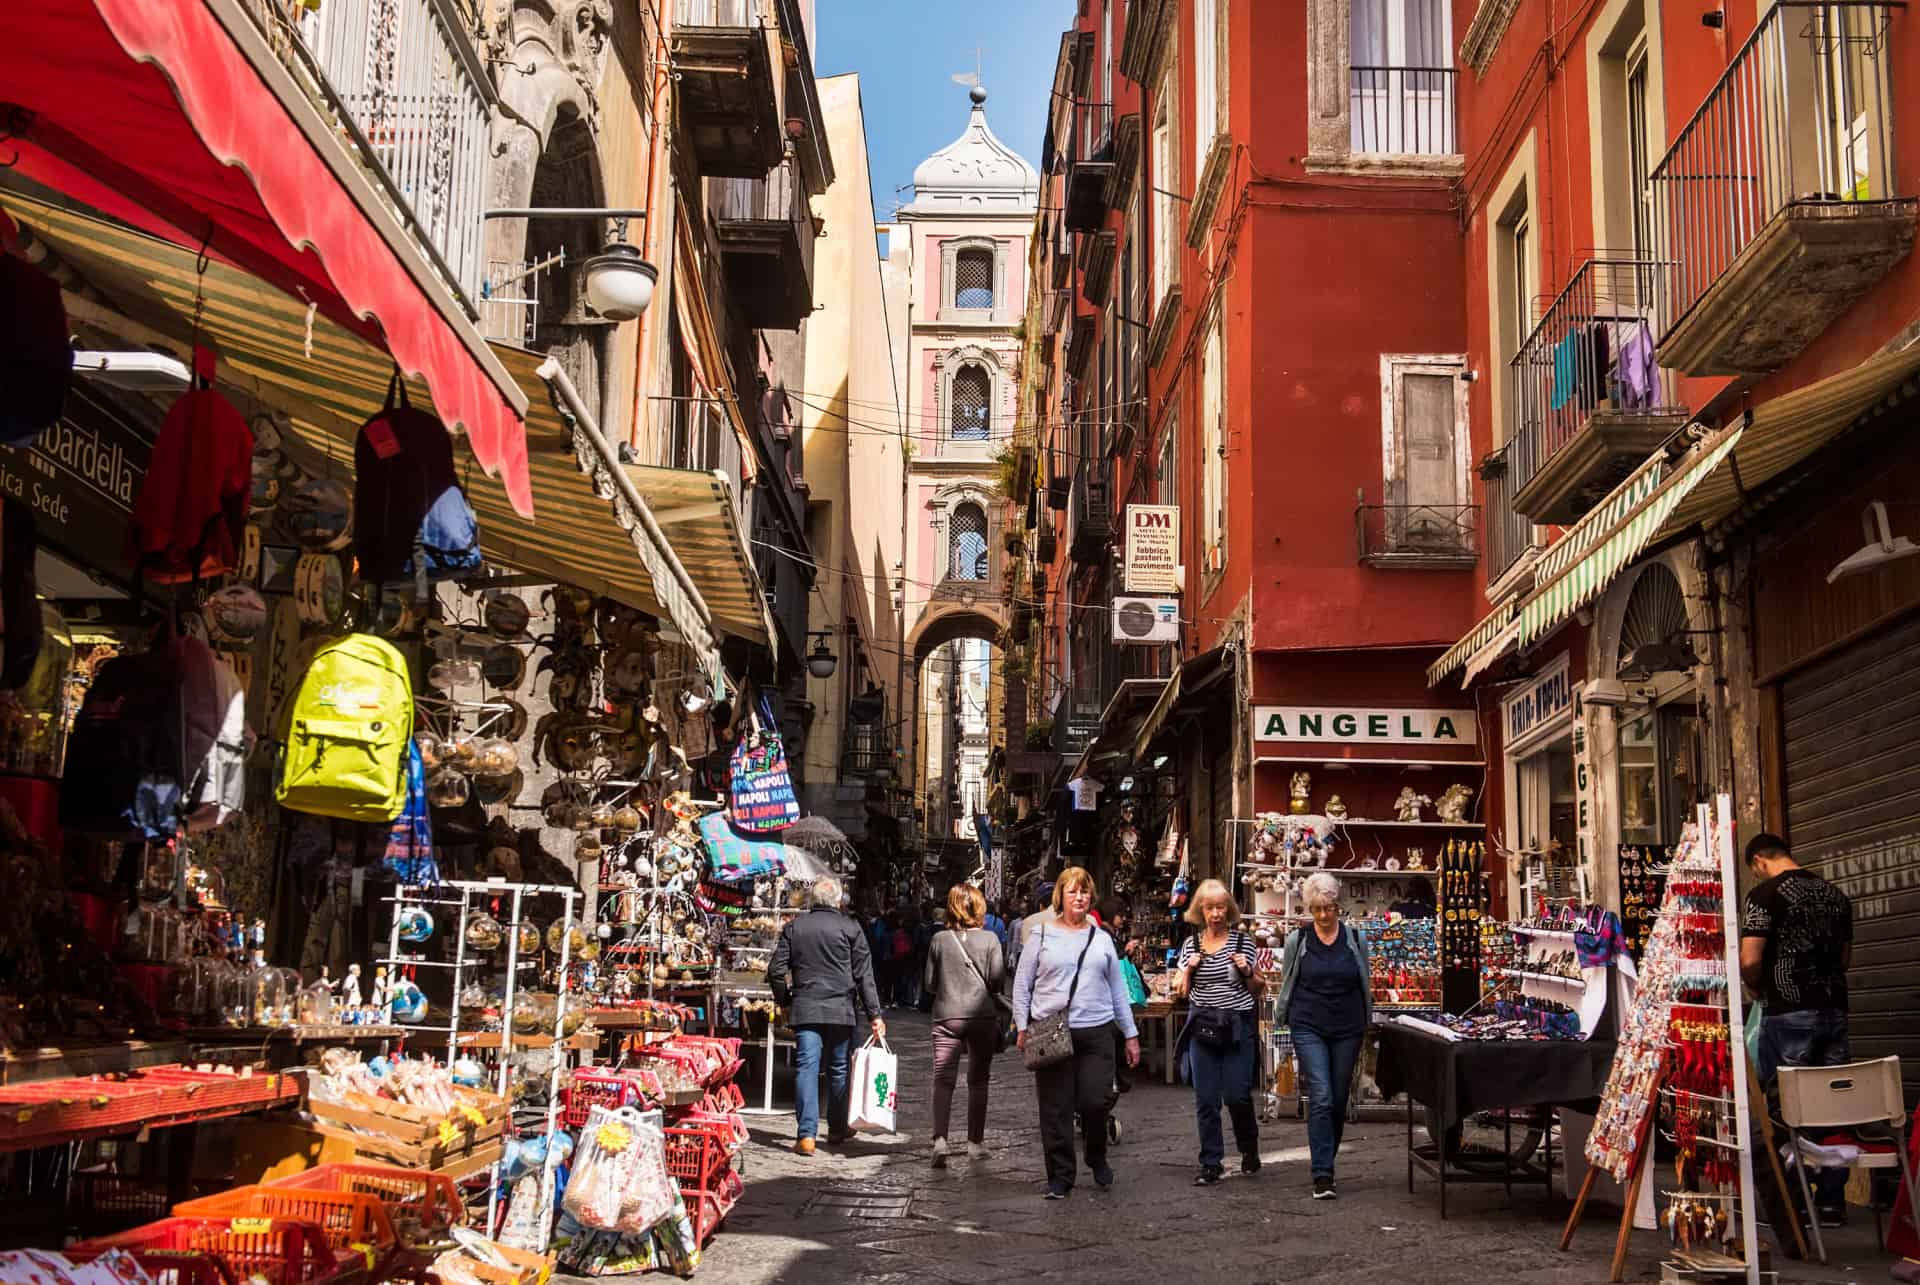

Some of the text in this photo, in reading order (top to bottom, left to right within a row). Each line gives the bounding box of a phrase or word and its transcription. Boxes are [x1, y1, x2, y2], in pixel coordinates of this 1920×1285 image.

[32, 482, 70, 524] Sede
[1135, 512, 1171, 528] DM
[1136, 546, 1169, 554] fabbrica
[1131, 562, 1174, 570] movimento
[1264, 713, 1458, 739] ANGELA
[754, 774, 784, 790] NAPOLI
[739, 792, 769, 805] NAPOLI
[752, 804, 784, 817] NAPOLI
